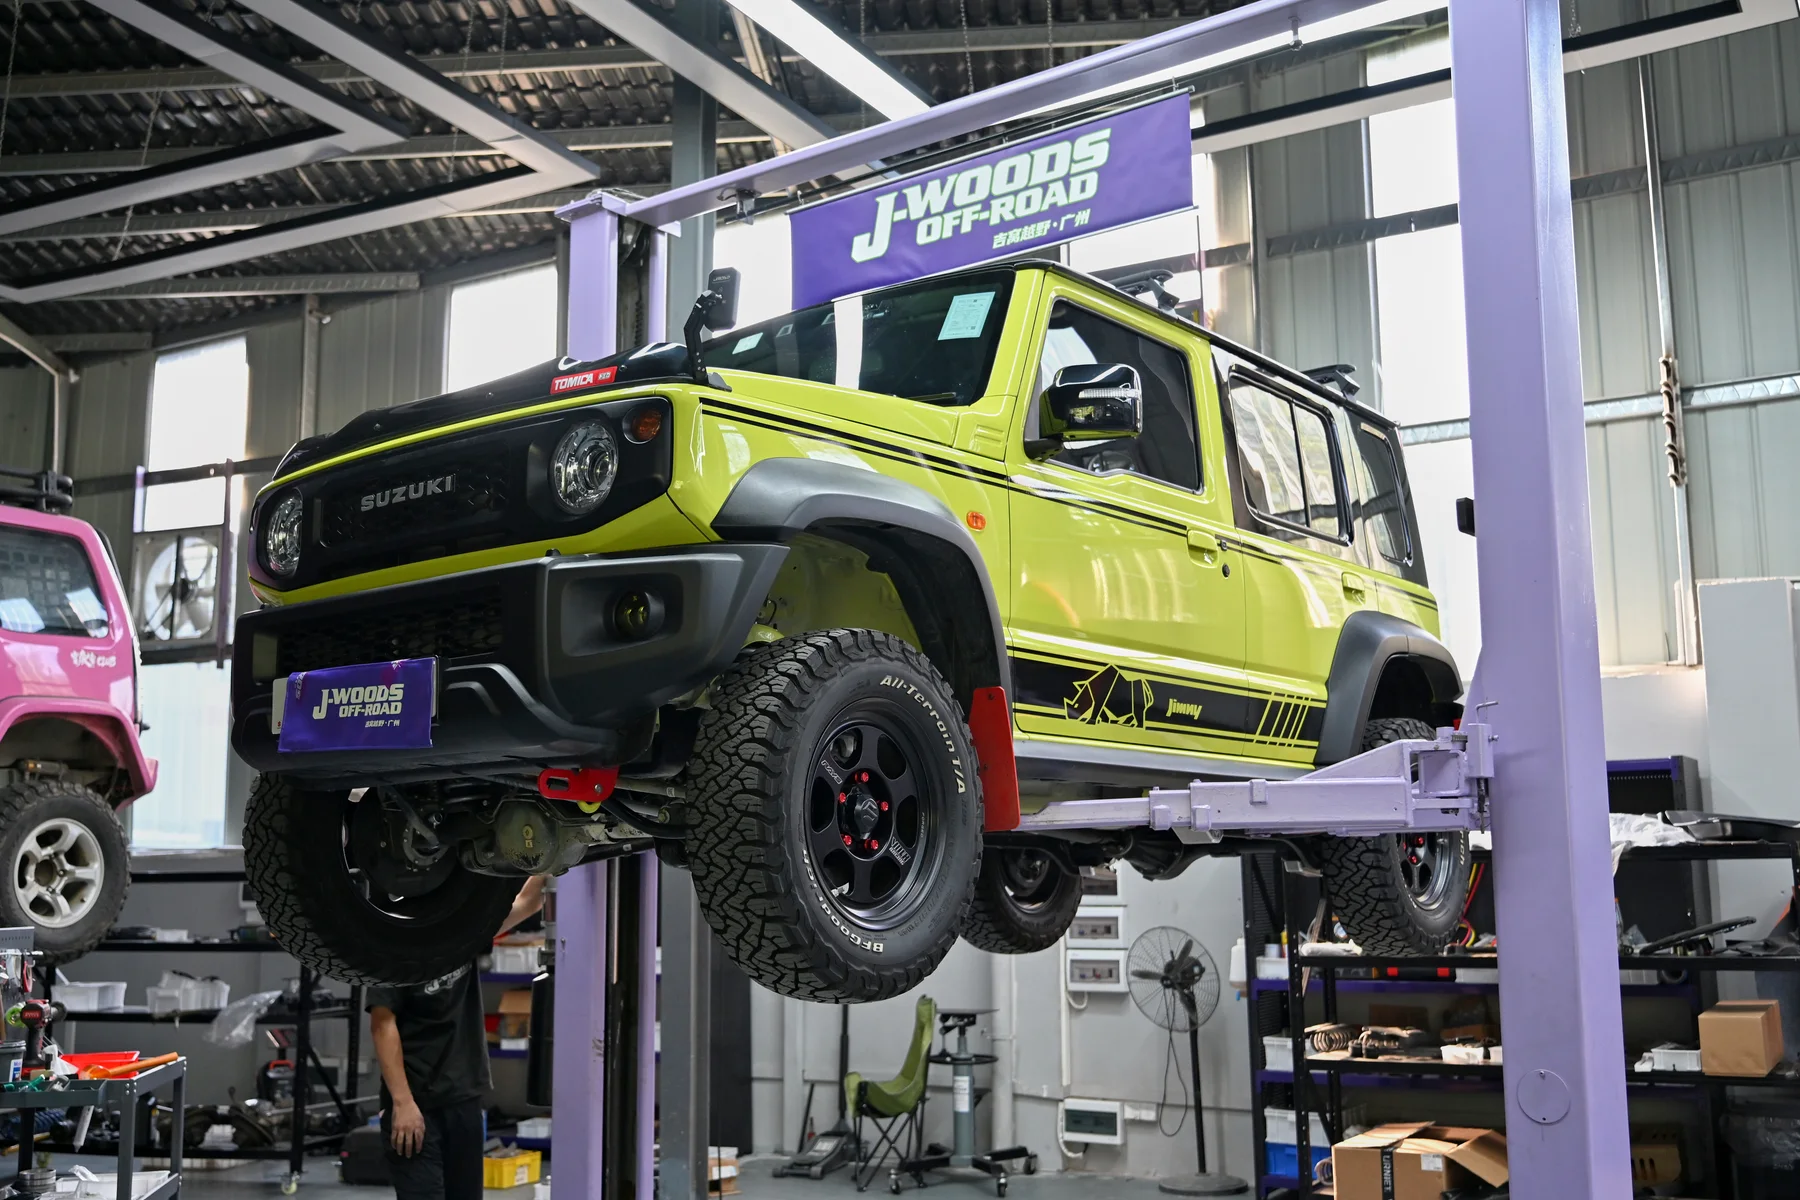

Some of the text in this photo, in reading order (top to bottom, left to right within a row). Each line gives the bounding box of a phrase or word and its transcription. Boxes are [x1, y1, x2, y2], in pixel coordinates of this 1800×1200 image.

[851, 128, 1112, 263] J-WOODS
[916, 170, 1099, 246] OFF-ROAD
[555, 373, 594, 391] TOMICA
[361, 475, 453, 512] SUZUKI
[312, 683, 405, 720] J-WOODS
[339, 701, 403, 718] OFF-ROAD
[1166, 698, 1202, 720] Jimny
[880, 675, 966, 794] All-Terrain T/A
